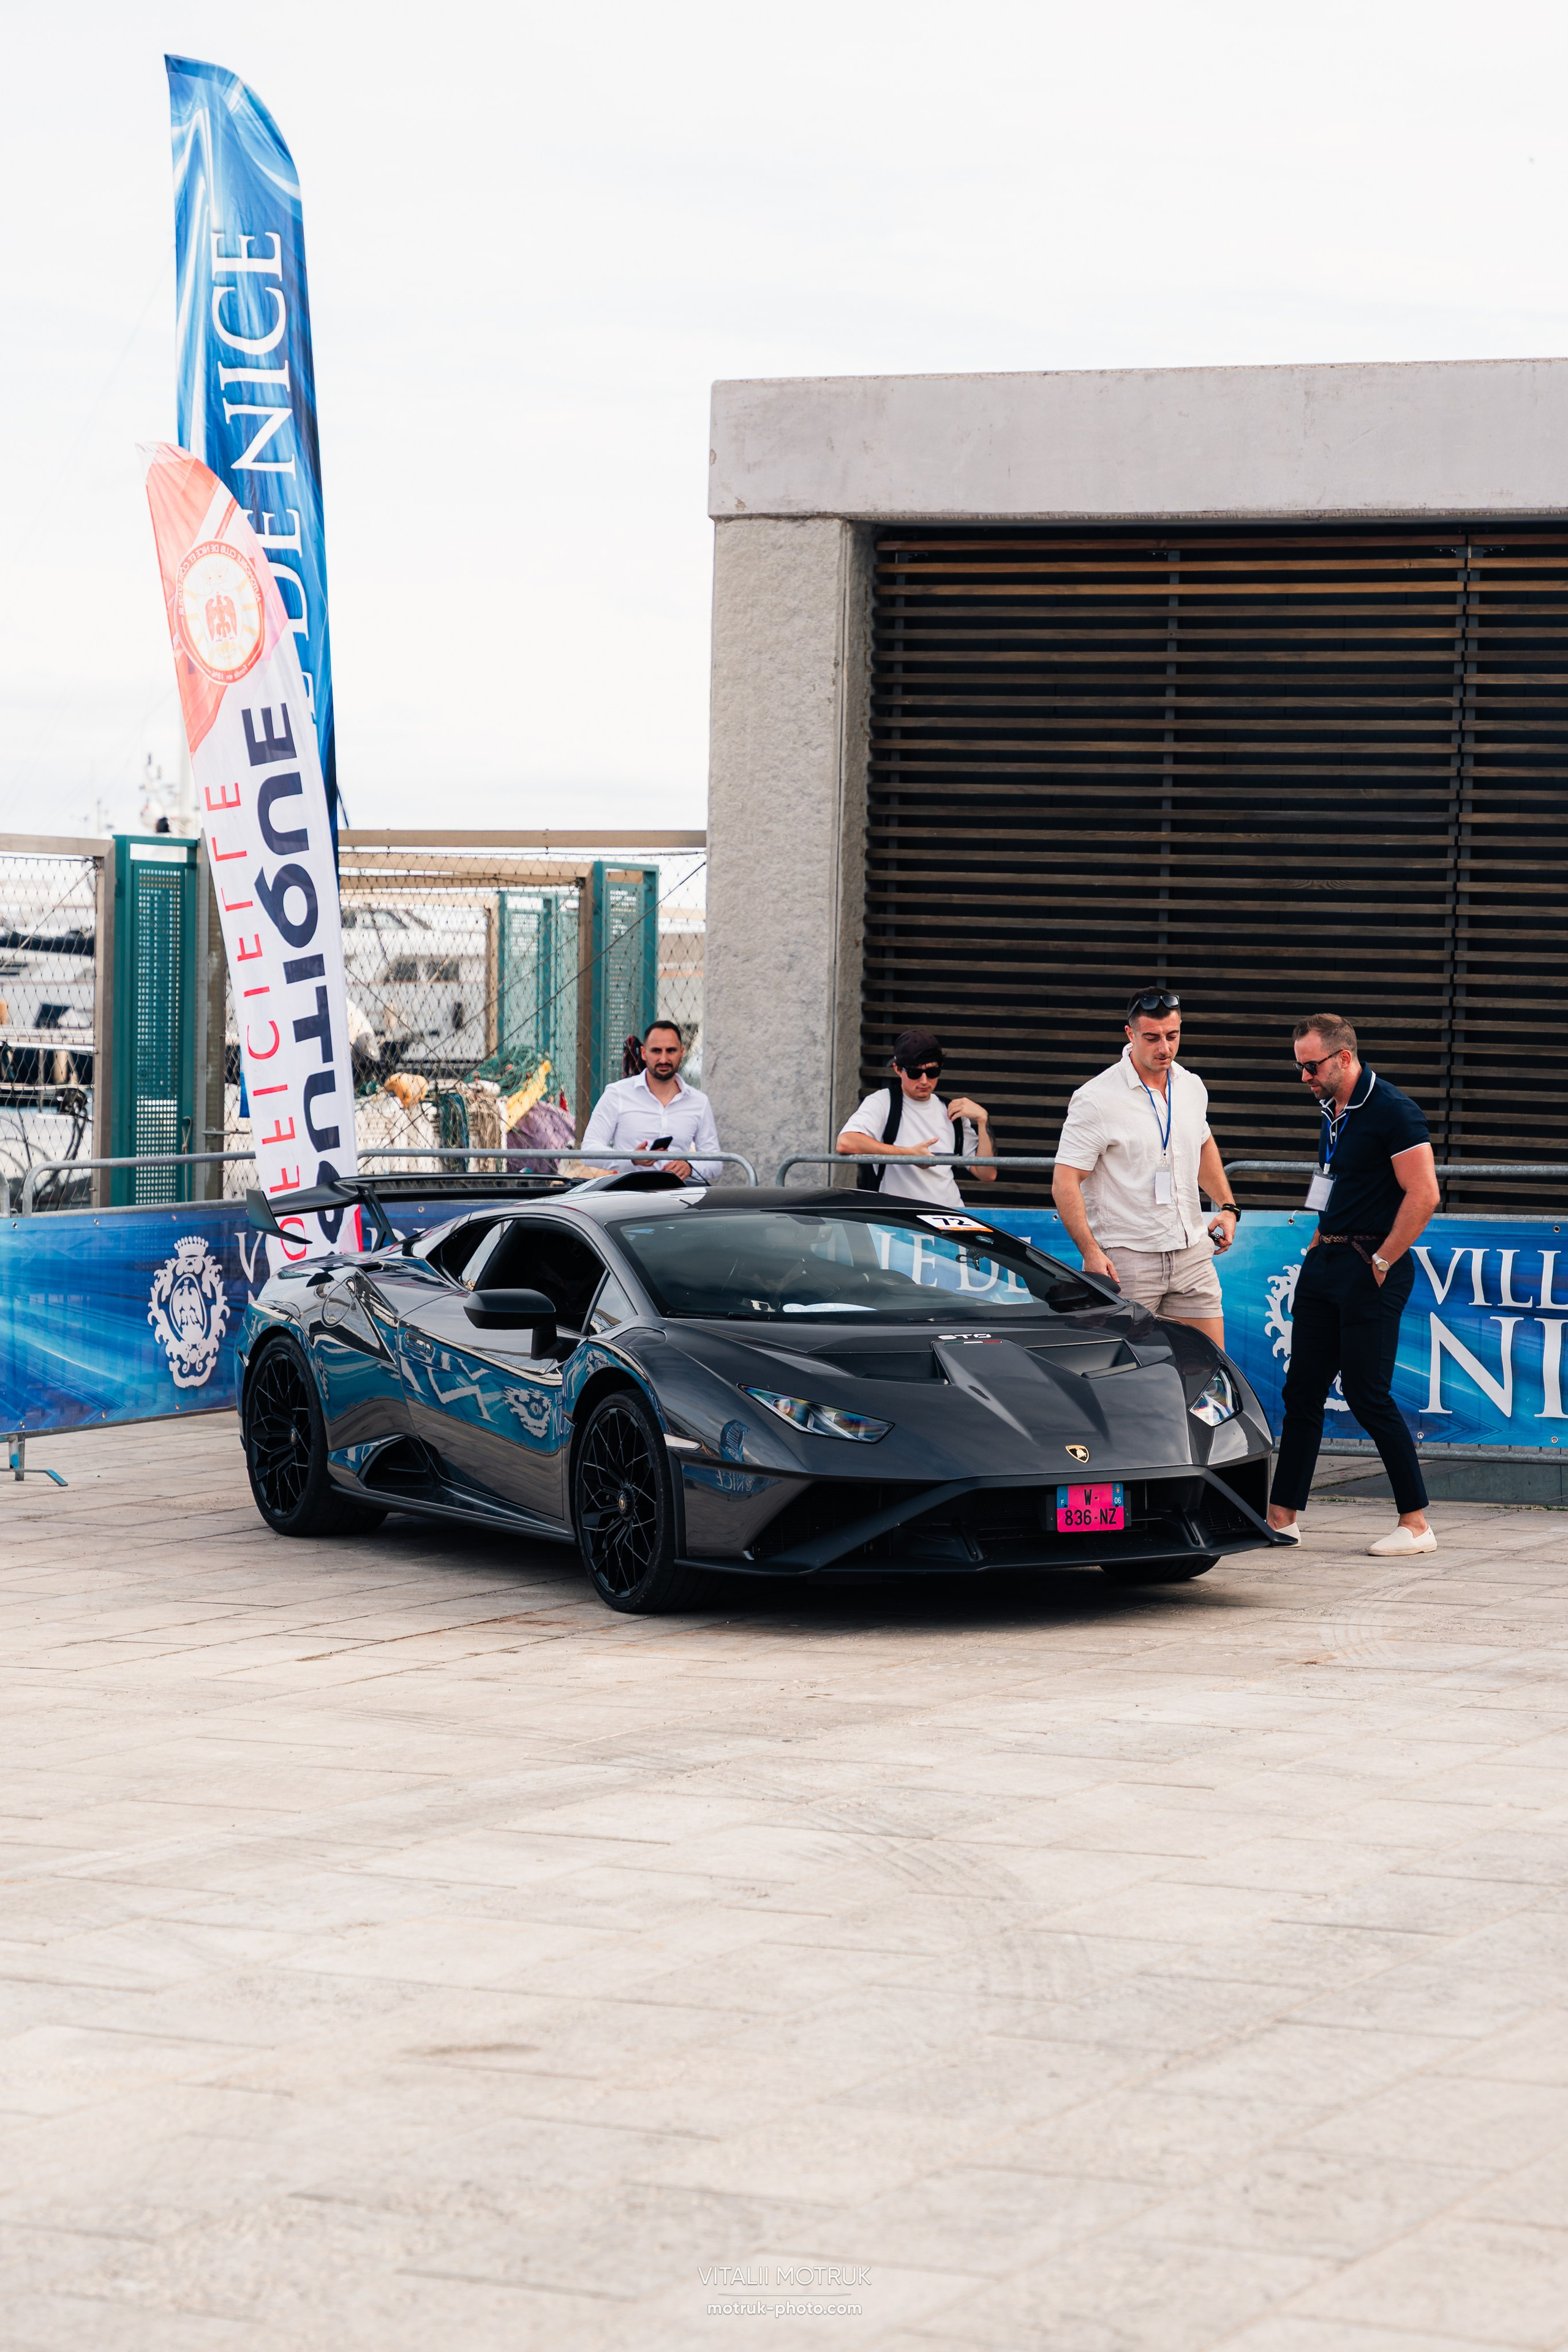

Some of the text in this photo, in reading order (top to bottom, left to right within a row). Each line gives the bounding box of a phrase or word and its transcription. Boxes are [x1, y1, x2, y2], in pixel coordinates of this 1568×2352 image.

[209, 232, 296, 481] NICE
[932, 1217, 972, 1226] 72
[1065, 1508, 1117, 1526] 836-NZ
